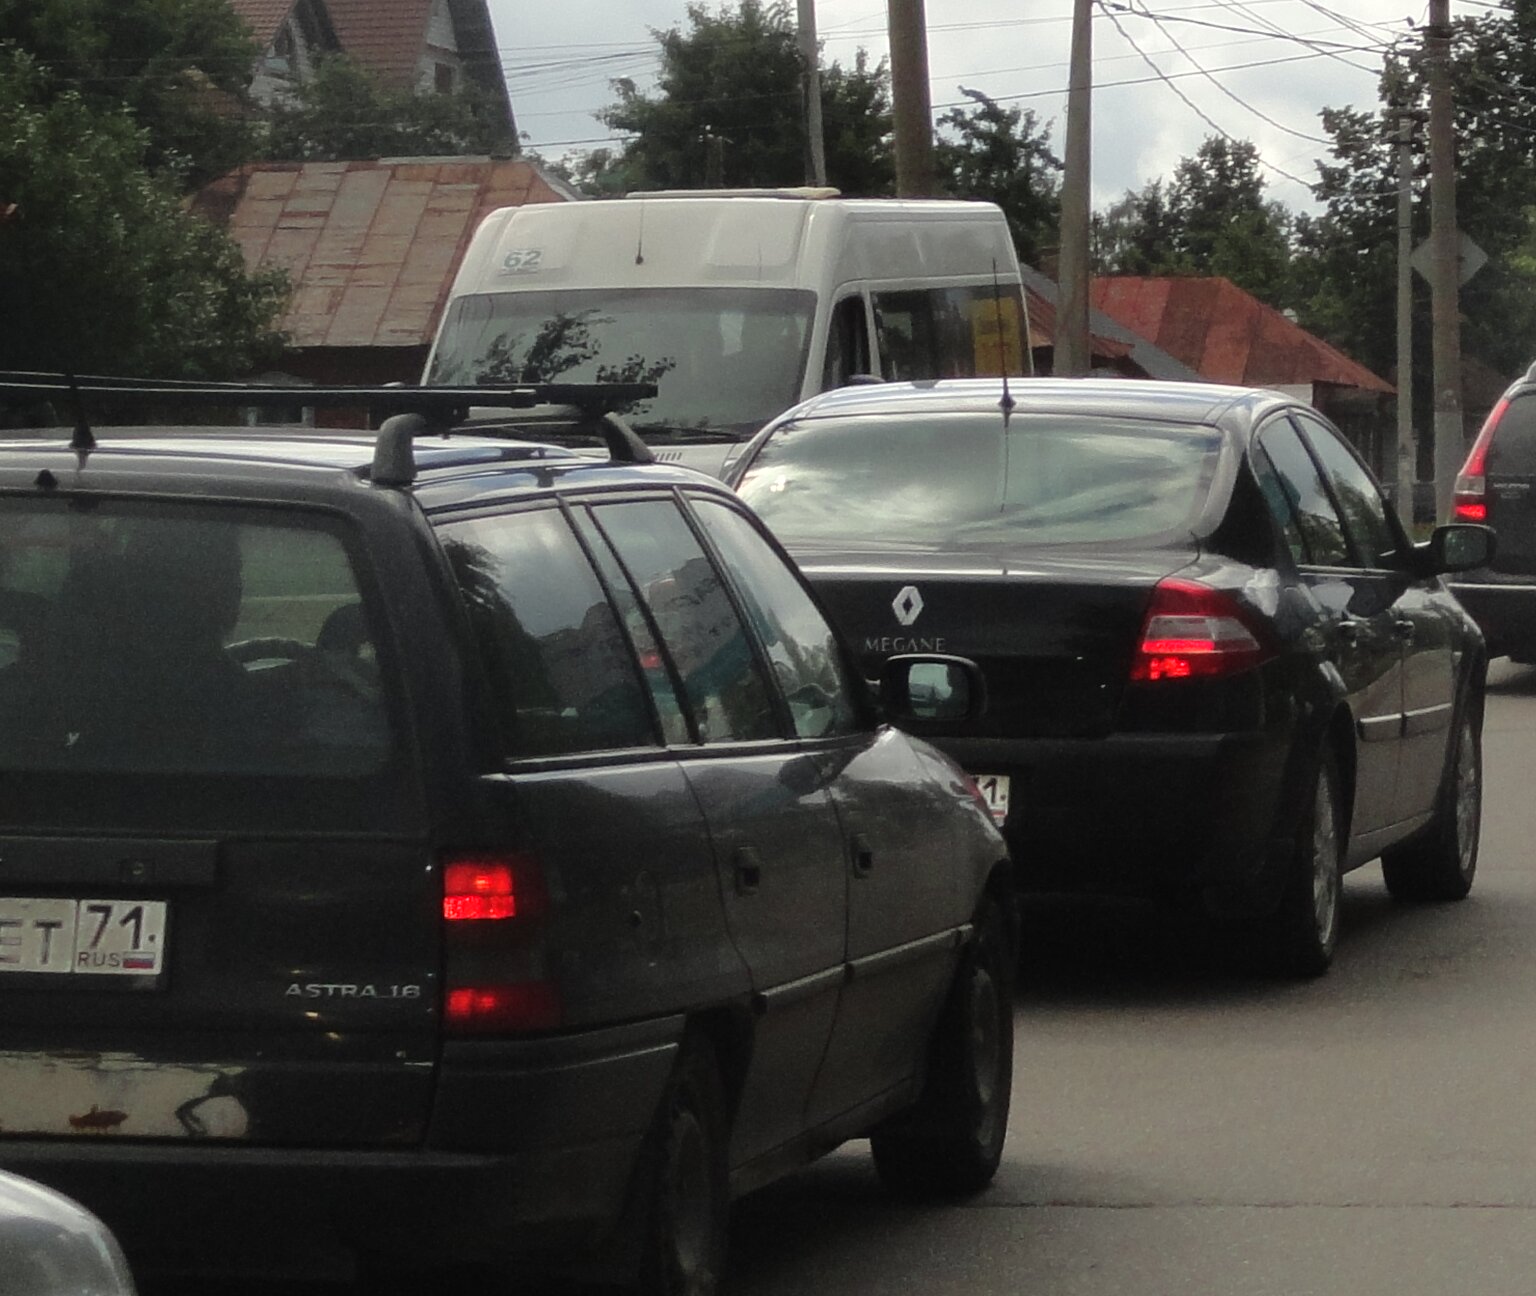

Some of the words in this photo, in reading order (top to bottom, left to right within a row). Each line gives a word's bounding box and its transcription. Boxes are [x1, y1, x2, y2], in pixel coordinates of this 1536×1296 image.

[503, 250, 541, 268] 62
[864, 637, 946, 653] MEGANE
[87, 905, 143, 950] 71
[78, 952, 121, 968] RUS
[285, 983, 377, 999] ASTRA
